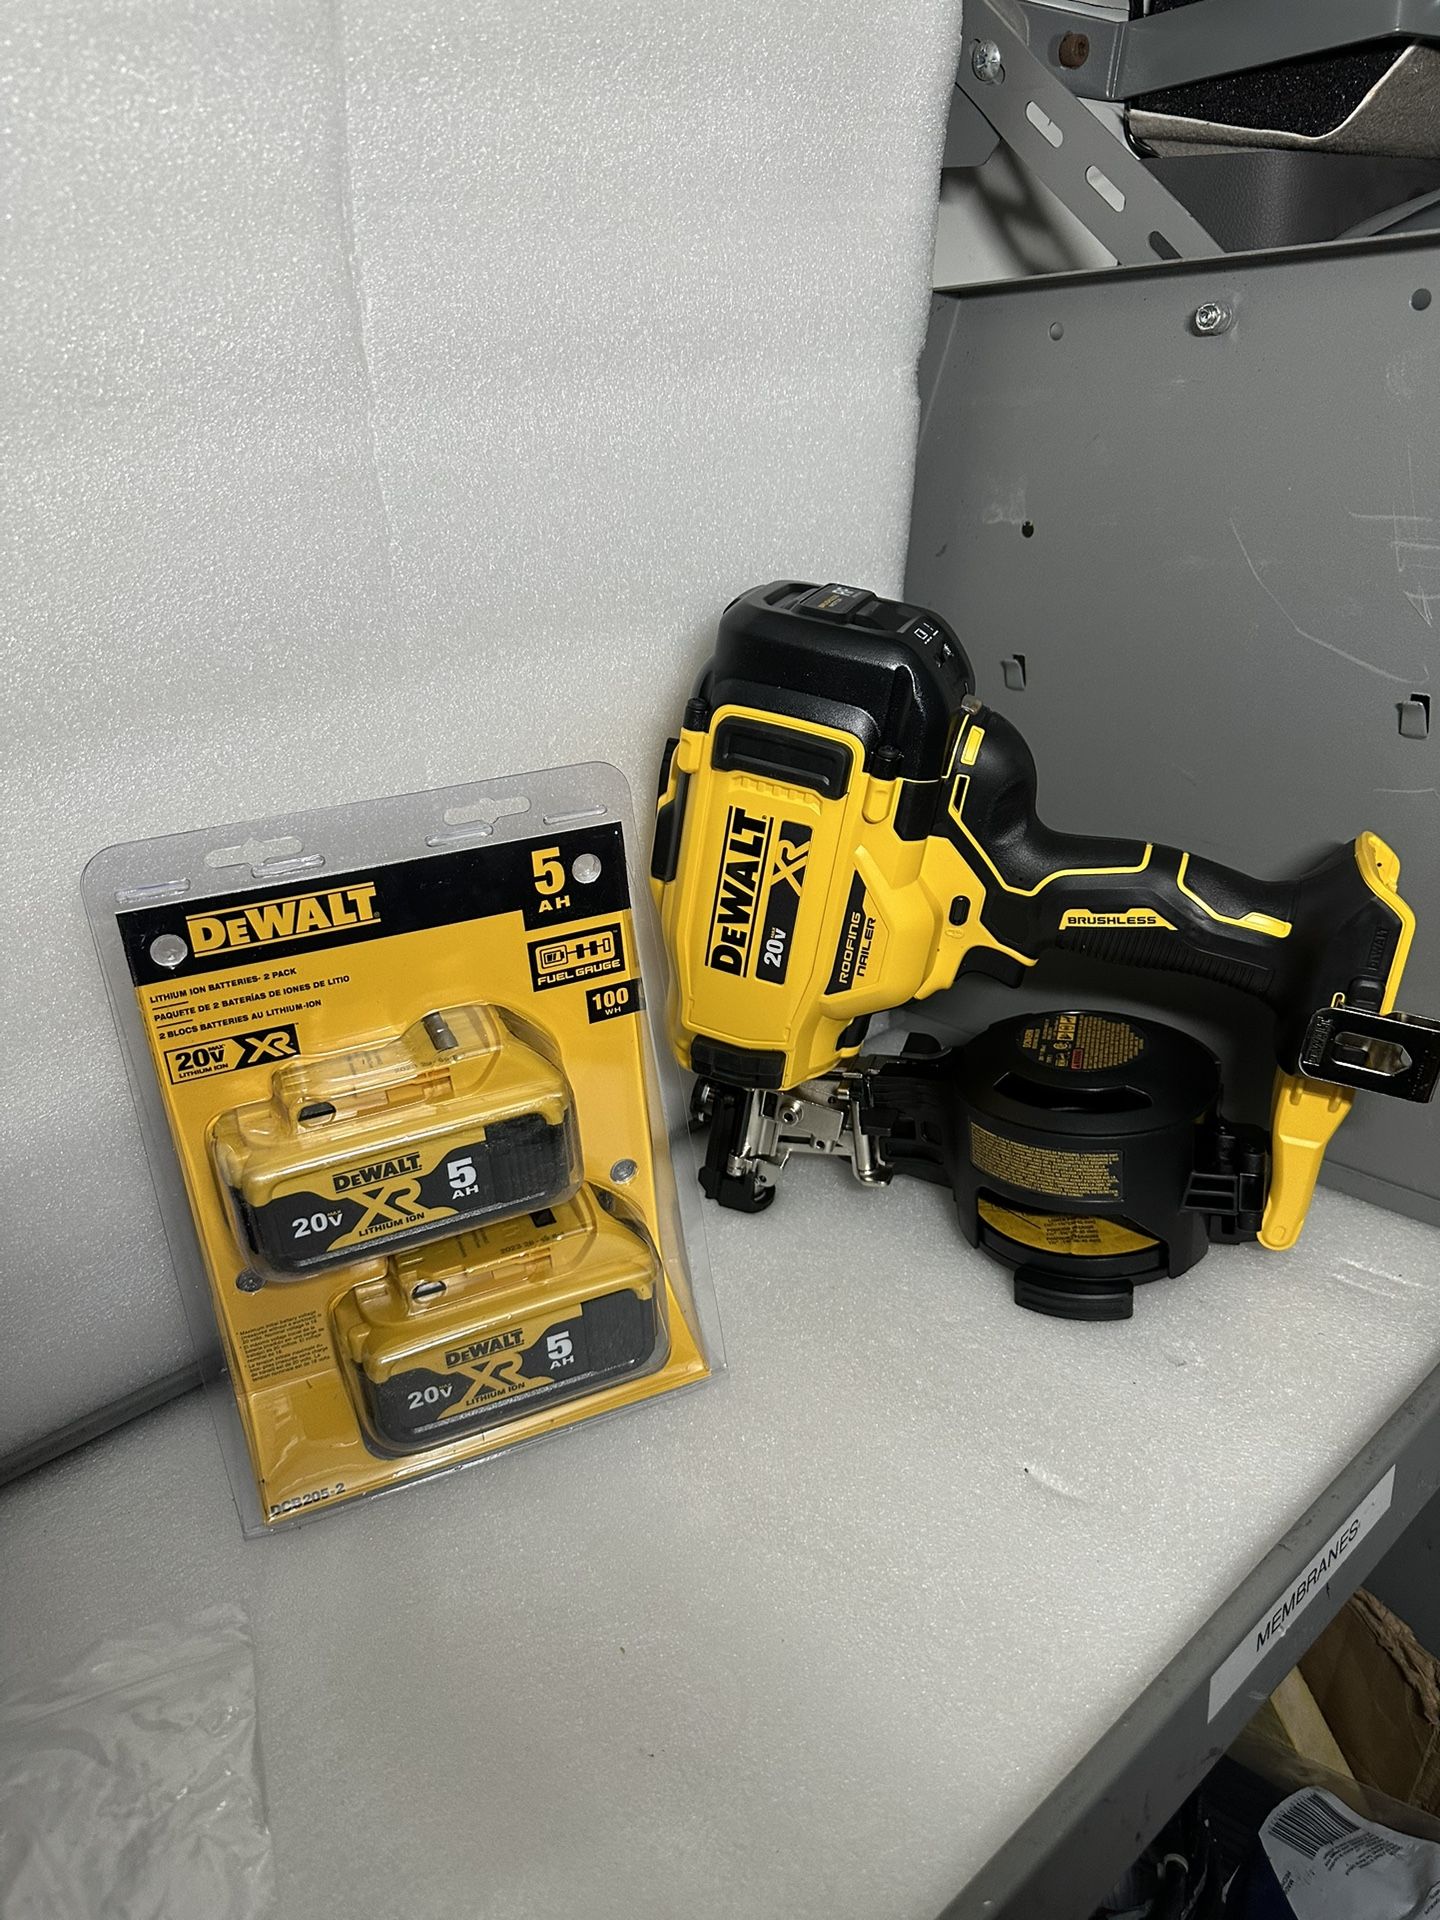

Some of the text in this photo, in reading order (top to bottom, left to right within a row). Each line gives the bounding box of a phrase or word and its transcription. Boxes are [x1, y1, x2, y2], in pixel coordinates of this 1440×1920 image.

[531, 846, 566, 895] 5
[538, 895, 571, 913] AH
[1067, 916, 1157, 925] BRUSHLESS
[839, 911, 861, 984] ROOFING
[857, 917, 877, 977] NAILER
[150, 990, 187, 1003] LITHIUM
[189, 985, 207, 995] ION
[272, 967, 297, 979] PACK
[537, 958, 621, 986] FUEL GAUGE
[197, 1004, 211, 1013] DE
[213, 1001, 220, 1009] 2
[222, 992, 267, 1008] BATERÍAS
[269, 989, 282, 998] DE
[283, 983, 311, 995] IONES
[313, 980, 326, 989] DE
[327, 975, 350, 986] LITIO
[592, 987, 629, 1010] 100
[158, 999, 322, 1040] 2 BLOCS BATTERIES AU LITHIUM-ION
[604, 1006, 622, 1016] WH
[245, 1031, 298, 1063] XR
[179, 1063, 229, 1079] LITHIUM ION
[446, 1157, 477, 1189] 5
[452, 1185, 479, 1200] AH
[358, 1212, 425, 1237] LITHIUM ION
[546, 1331, 573, 1360] 5
[550, 1355, 575, 1370] AH
[466, 1382, 526, 1406] LITHIUM ION
[270, 1482, 346, 1517] DCB205-2
[1256, 1519, 1359, 1652] MEMBRANES
